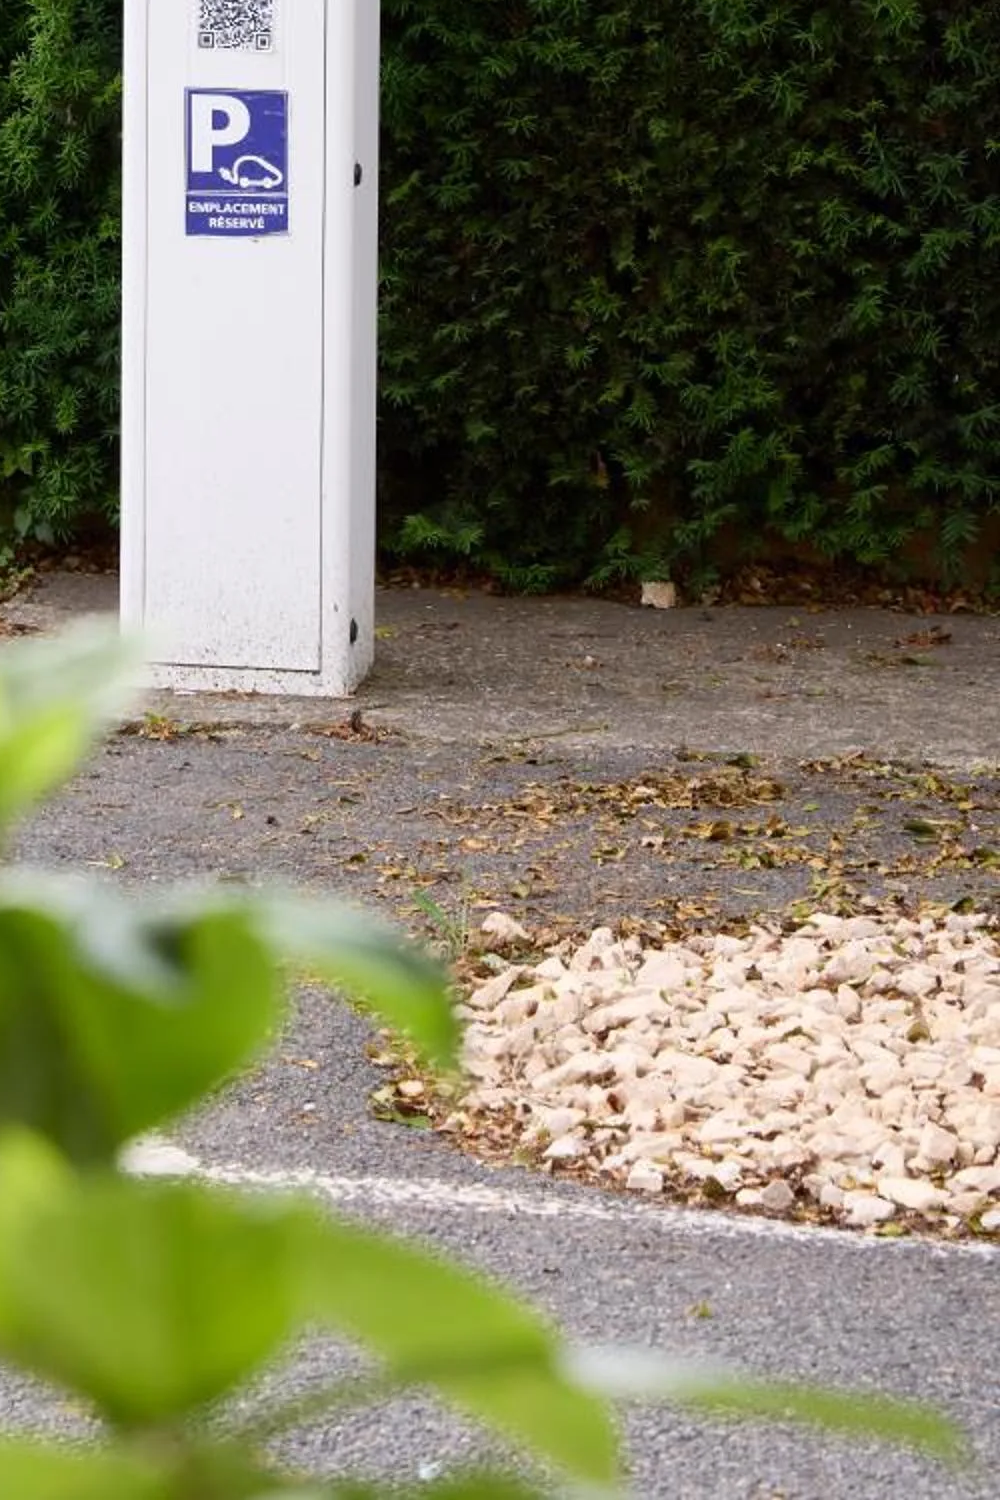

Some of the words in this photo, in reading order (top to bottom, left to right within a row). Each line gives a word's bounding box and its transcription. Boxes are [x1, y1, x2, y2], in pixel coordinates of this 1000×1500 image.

[192, 94, 250, 172] P
[189, 201, 285, 215] EMPLACEMENT
[209, 216, 264, 229] RÉSERVÉ
